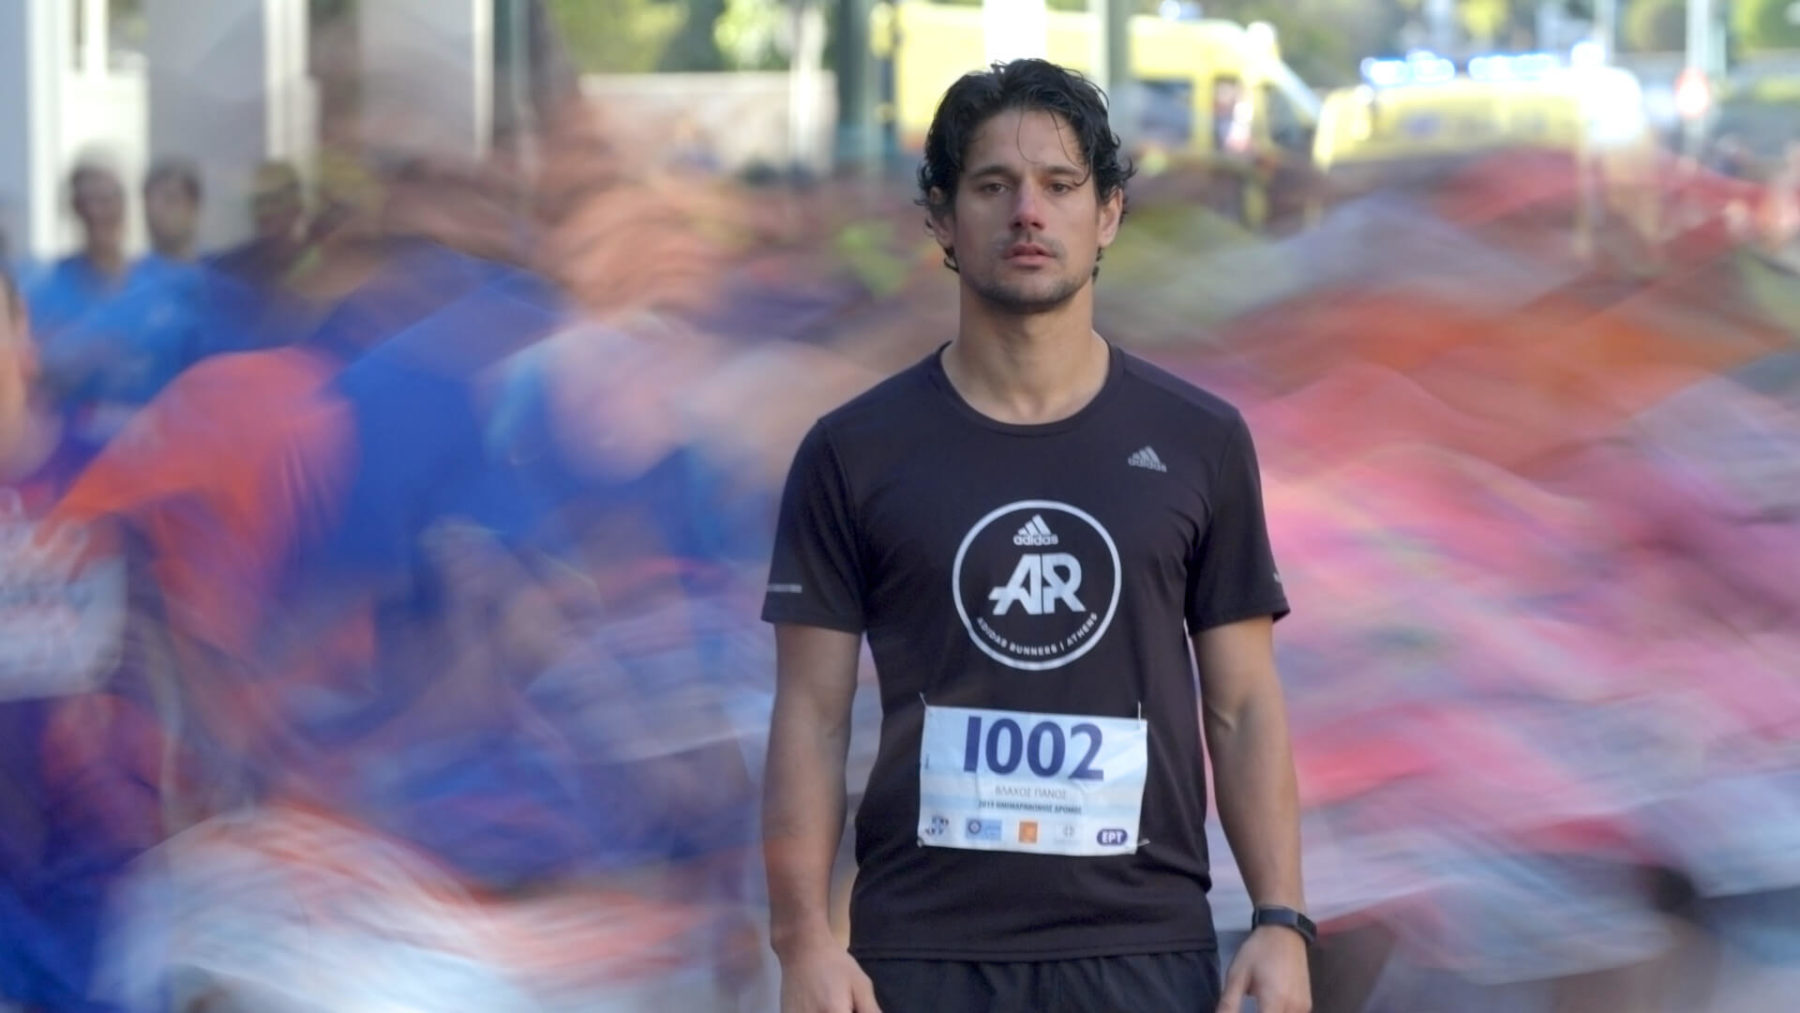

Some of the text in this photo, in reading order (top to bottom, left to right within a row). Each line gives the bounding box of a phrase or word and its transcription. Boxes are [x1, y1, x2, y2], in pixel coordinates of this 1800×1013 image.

[1013, 533, 1058, 546] adidas
[988, 552, 1086, 616] AR
[977, 617, 1008, 648] ADIDAS
[1009, 642, 1058, 656] RUNNERS
[1066, 612, 1098, 646] ATHENS
[963, 716, 1104, 782] 1002
